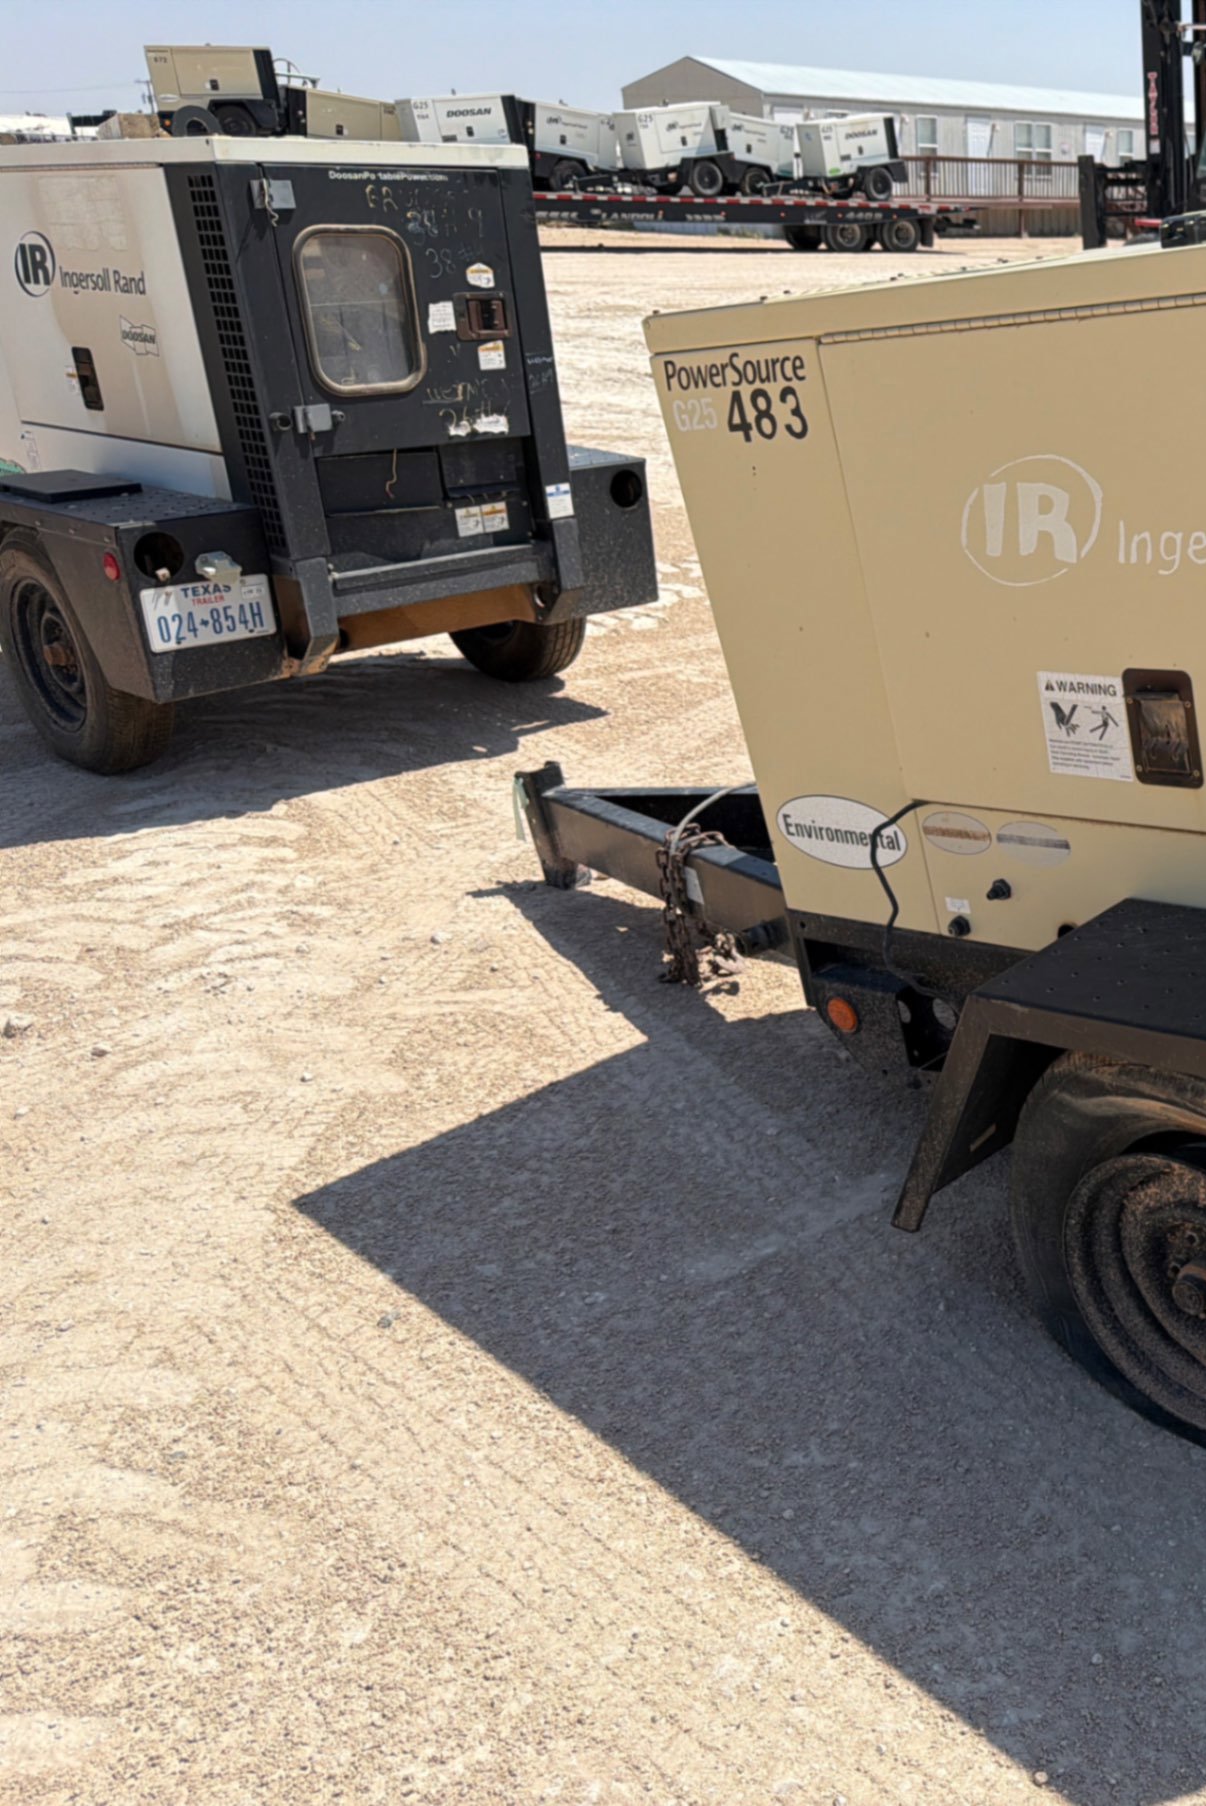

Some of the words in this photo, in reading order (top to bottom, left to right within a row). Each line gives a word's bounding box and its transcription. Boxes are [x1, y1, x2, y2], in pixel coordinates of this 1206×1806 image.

[446, 107, 492, 118] DOOSAN
[59, 265, 112, 295] Ingersoll
[112, 269, 147, 296] Rand
[121, 330, 157, 345] DOOSAN
[663, 352, 807, 392] PowerSource
[672, 397, 719, 433] G25
[727, 385, 809, 443] 483
[982, 481, 1078, 565] IR
[181, 583, 232, 599] TEXAS
[191, 595, 225, 607] TRAILER
[1056, 680, 1117, 697] WARNING
